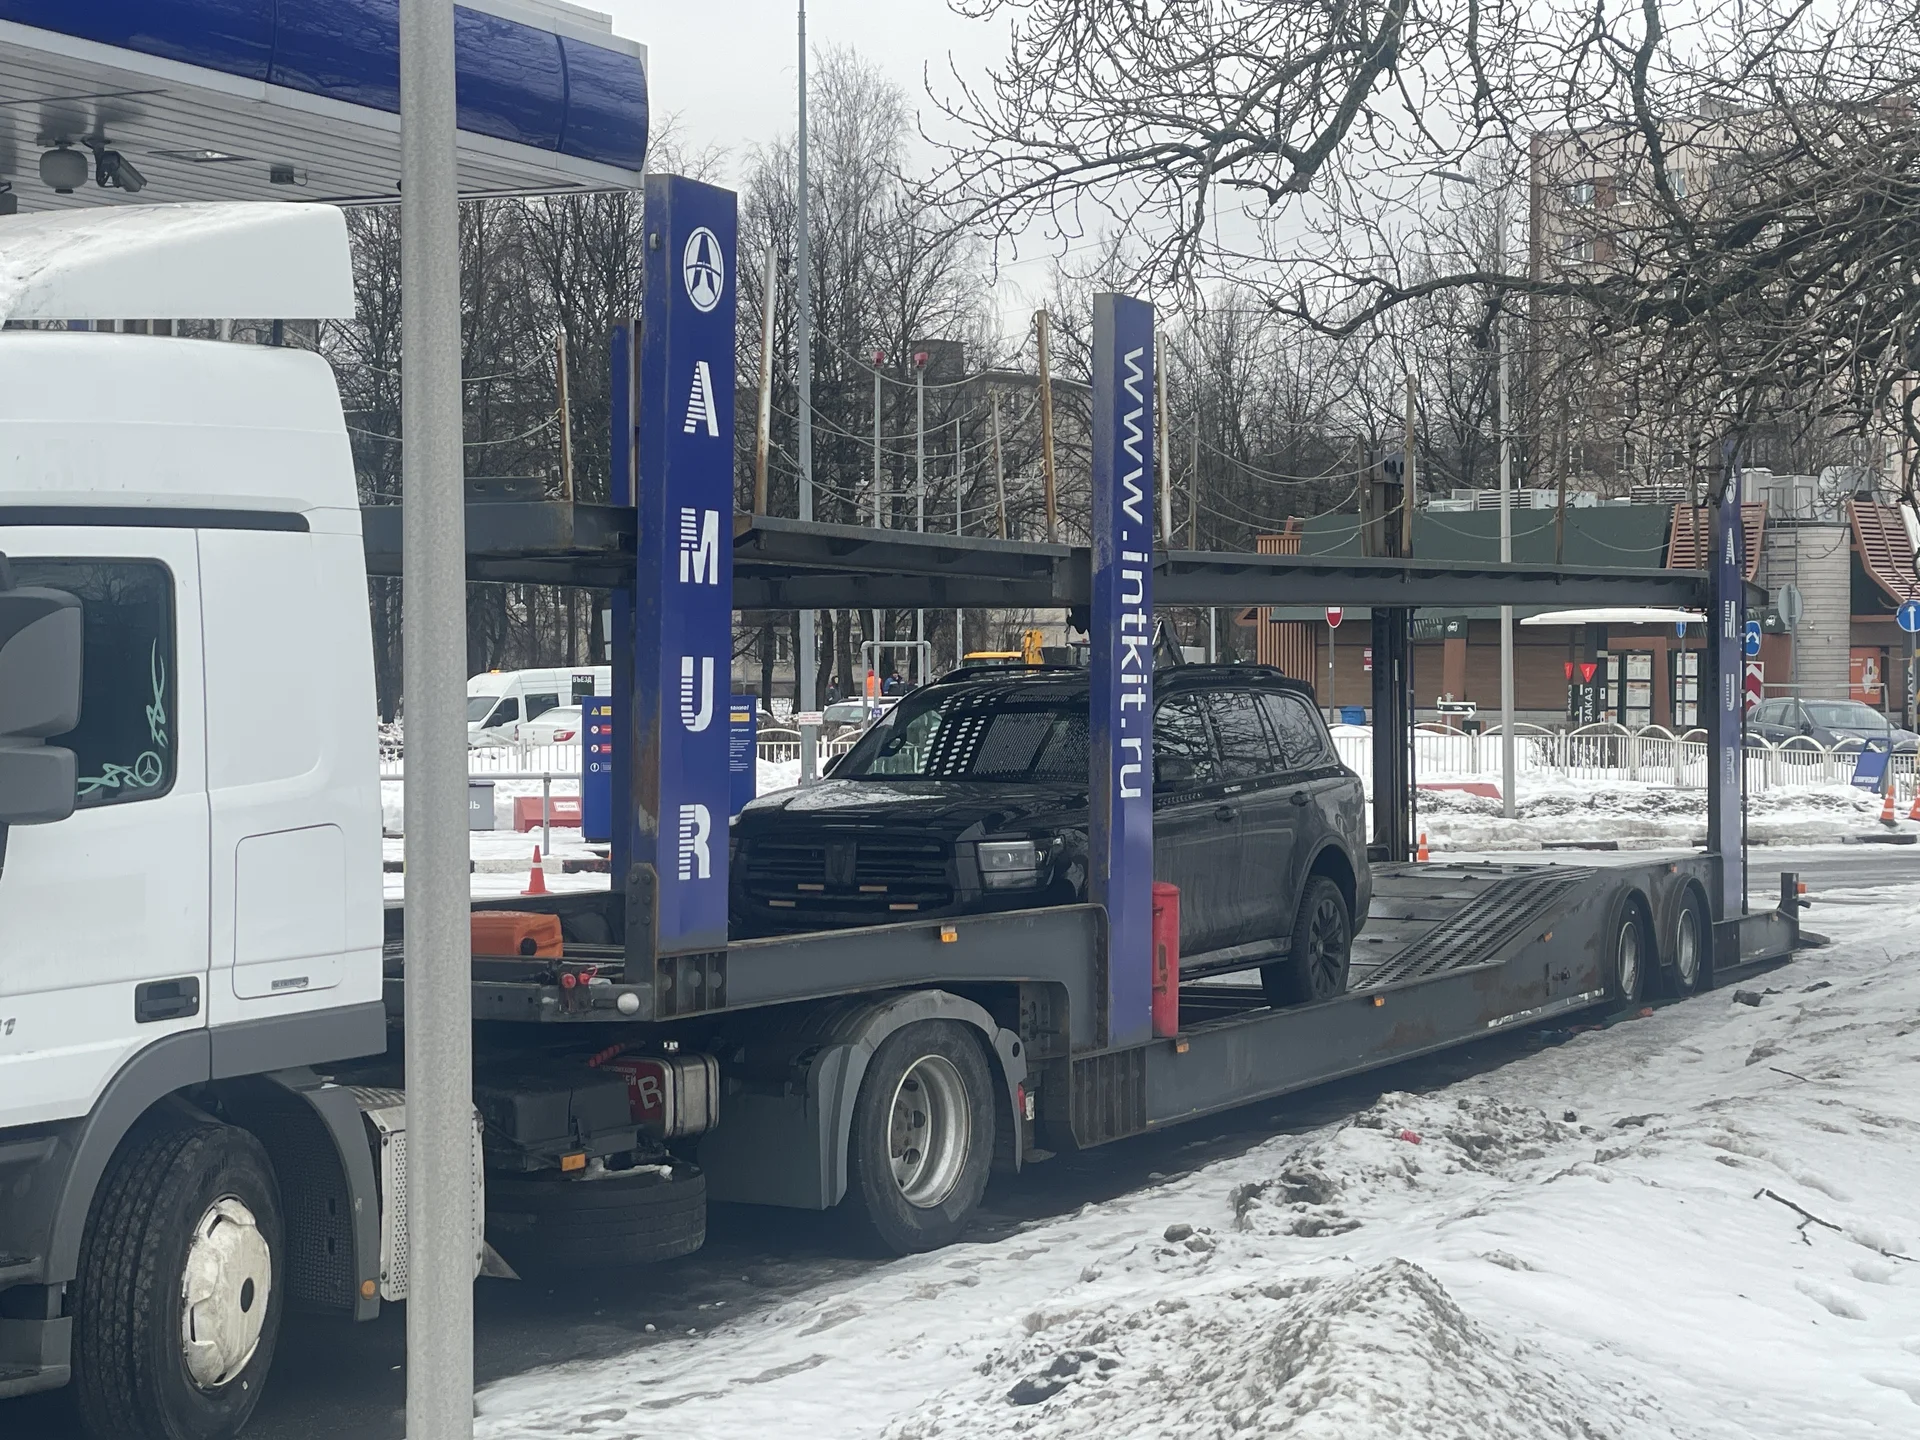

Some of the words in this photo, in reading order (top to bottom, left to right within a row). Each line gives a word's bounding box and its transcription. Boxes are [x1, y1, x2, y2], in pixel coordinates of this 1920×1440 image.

[679, 360, 719, 880] AMUR
[1120, 346, 1148, 798] www.intkit.ru
[1584, 687, 1593, 722] ЗАКАЗ
